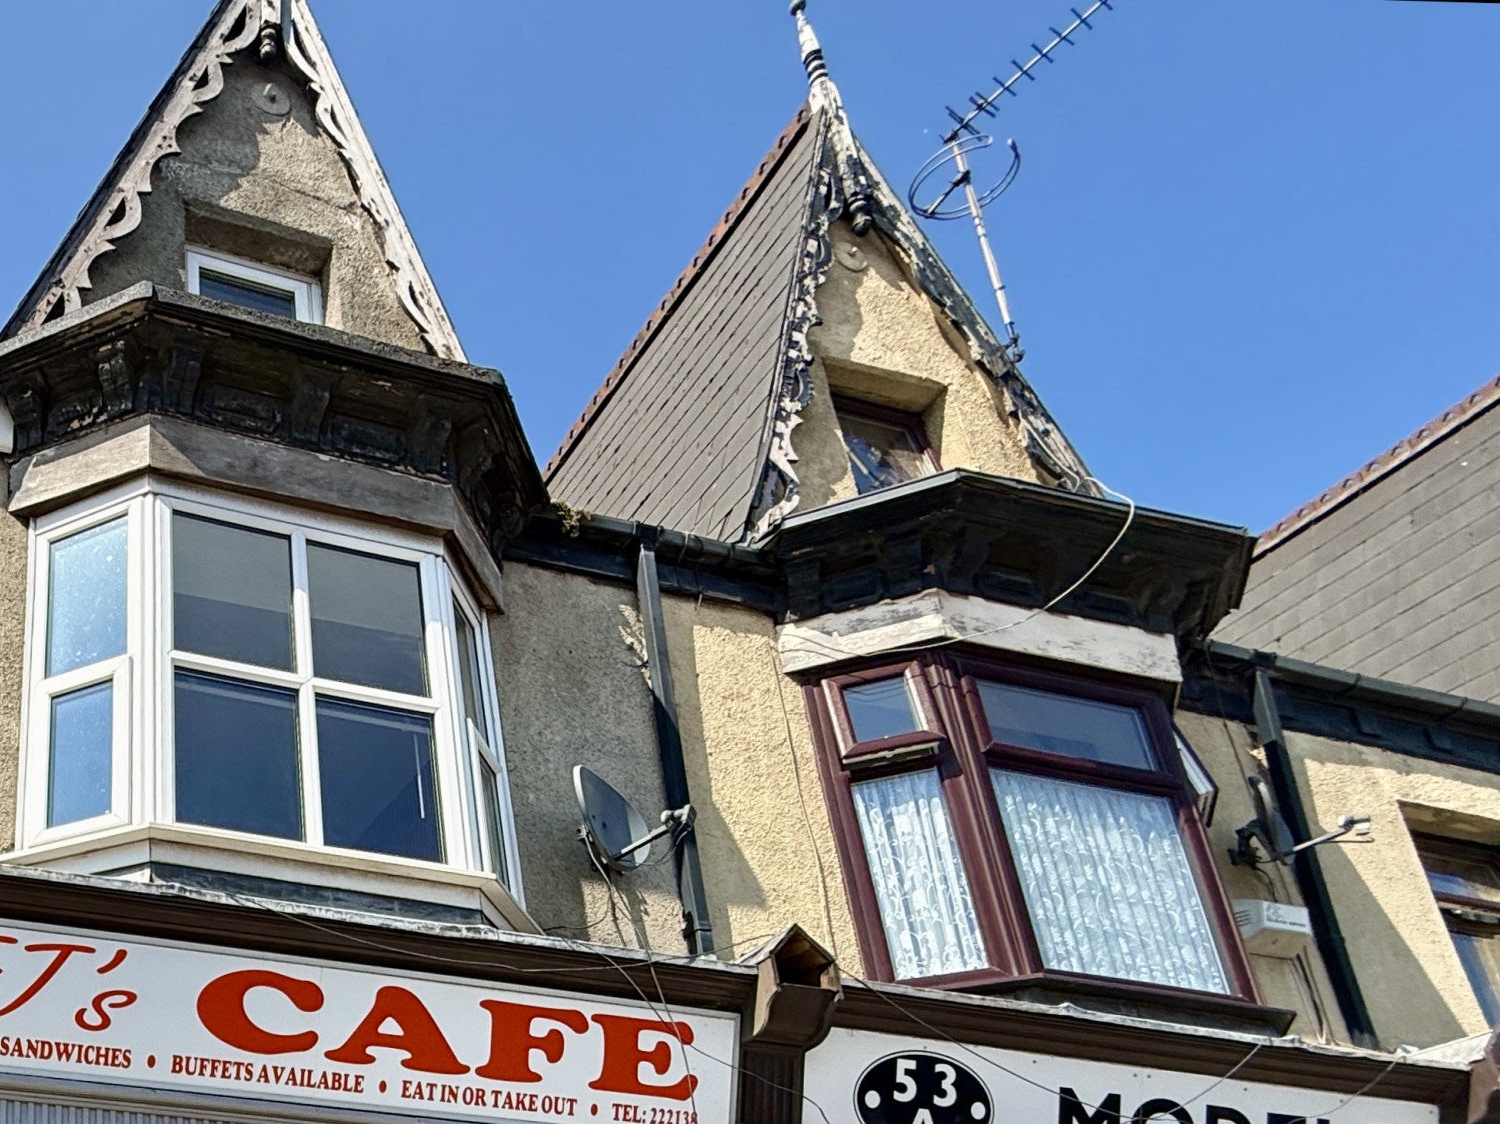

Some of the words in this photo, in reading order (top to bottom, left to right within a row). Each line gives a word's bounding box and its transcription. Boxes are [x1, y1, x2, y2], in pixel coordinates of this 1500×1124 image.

[0, 1036, 131, 1069] SANDWICHES
[196, 969, 698, 1101] CAFE
[171, 1054, 254, 1082] BUFFETS
[257, 1064, 365, 1093] AVAILABLE
[401, 1080, 437, 1102] EAT
[440, 1083, 459, 1104] IN
[462, 1087, 487, 1107] OR
[490, 1090, 539, 1113] TAKE
[541, 1095, 577, 1116] OUT
[612, 1103, 646, 1124] TEL:
